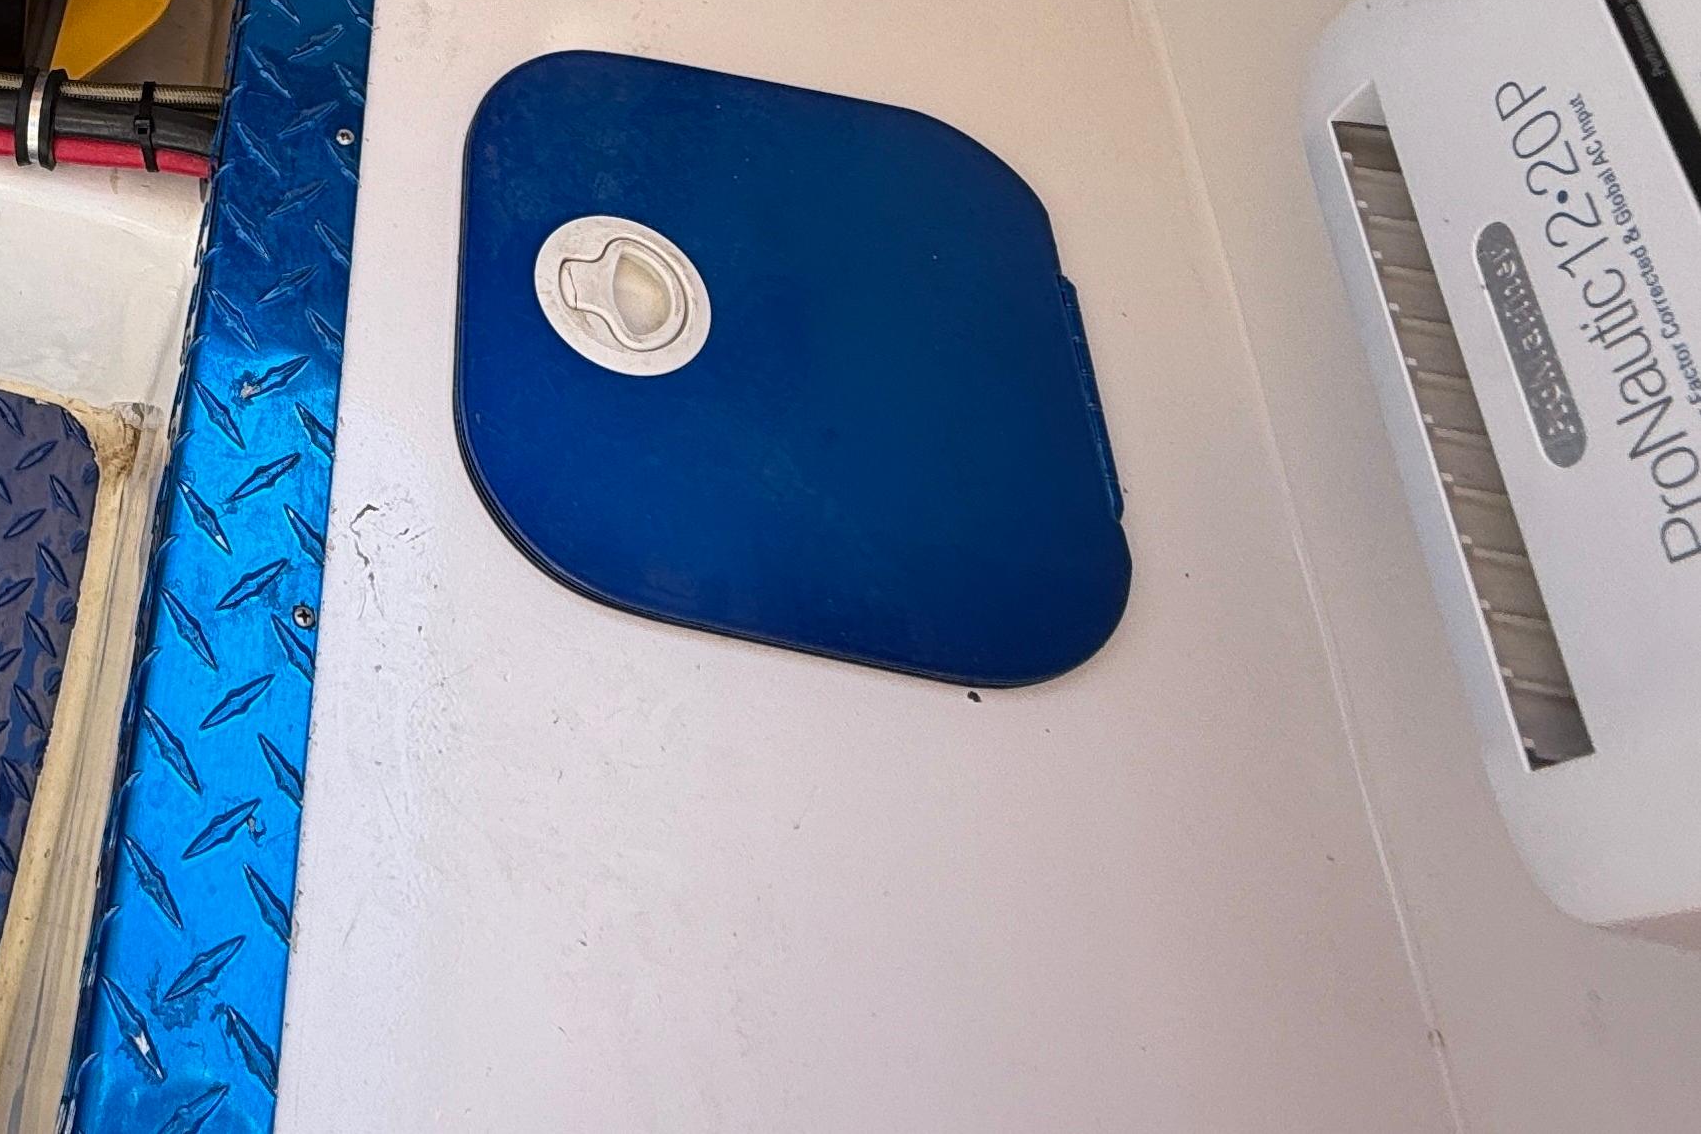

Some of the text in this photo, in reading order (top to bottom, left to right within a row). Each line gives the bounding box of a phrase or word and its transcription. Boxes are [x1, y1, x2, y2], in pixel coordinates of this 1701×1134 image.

[1568, 92, 1701, 406] Factor Corrected & Global AC Input
